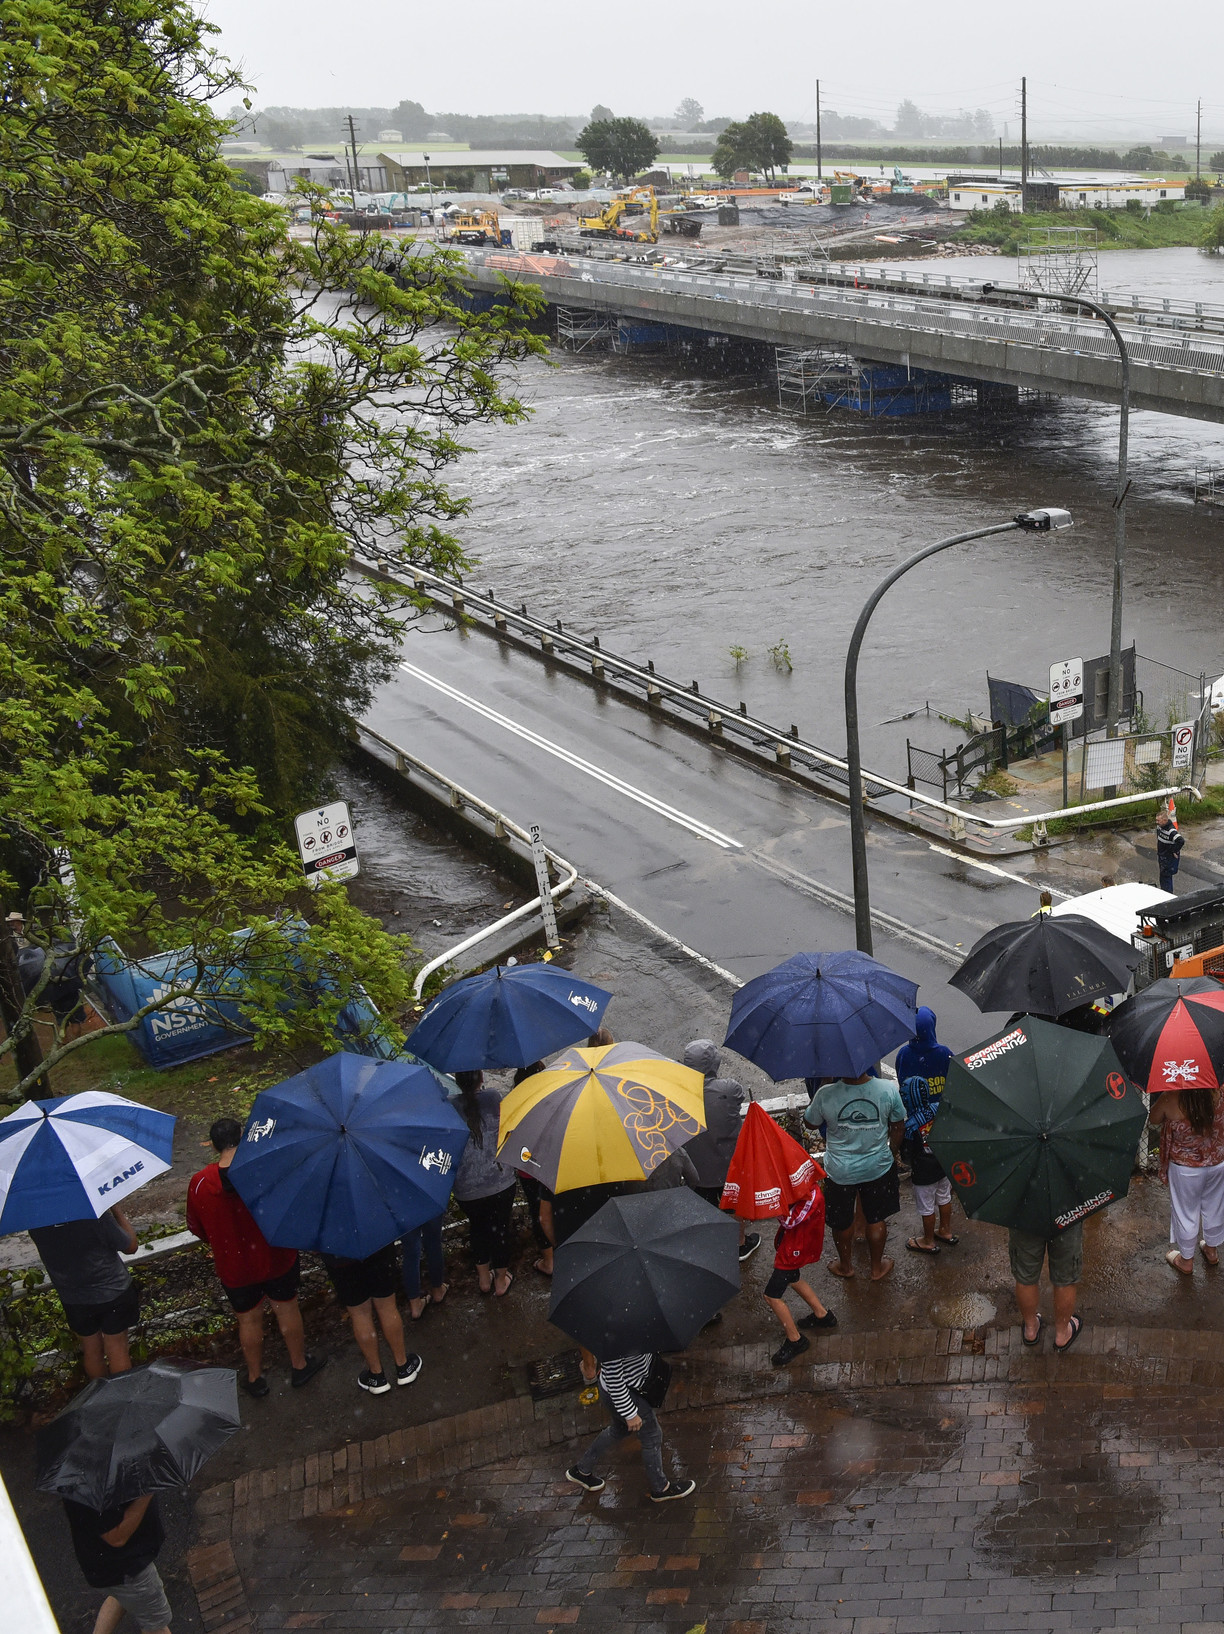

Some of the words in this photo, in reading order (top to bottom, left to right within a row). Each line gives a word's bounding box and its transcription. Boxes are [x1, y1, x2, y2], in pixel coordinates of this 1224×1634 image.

[1062, 668, 1071, 676] NO
[1177, 746, 1188, 754] NO
[316, 817, 329, 827] NO
[532, 833, 540, 843] 2
[318, 854, 343, 867] DANGER
[155, 1021, 209, 1042] GOVERNMENT
[967, 1034, 1027, 1071] BUNNINGS
[969, 1030, 1020, 1062] warehouse
[97, 1160, 145, 1196] KANE
[1054, 1188, 1113, 1225] BUNNINGS
[1061, 1196, 1110, 1227] warehouse
